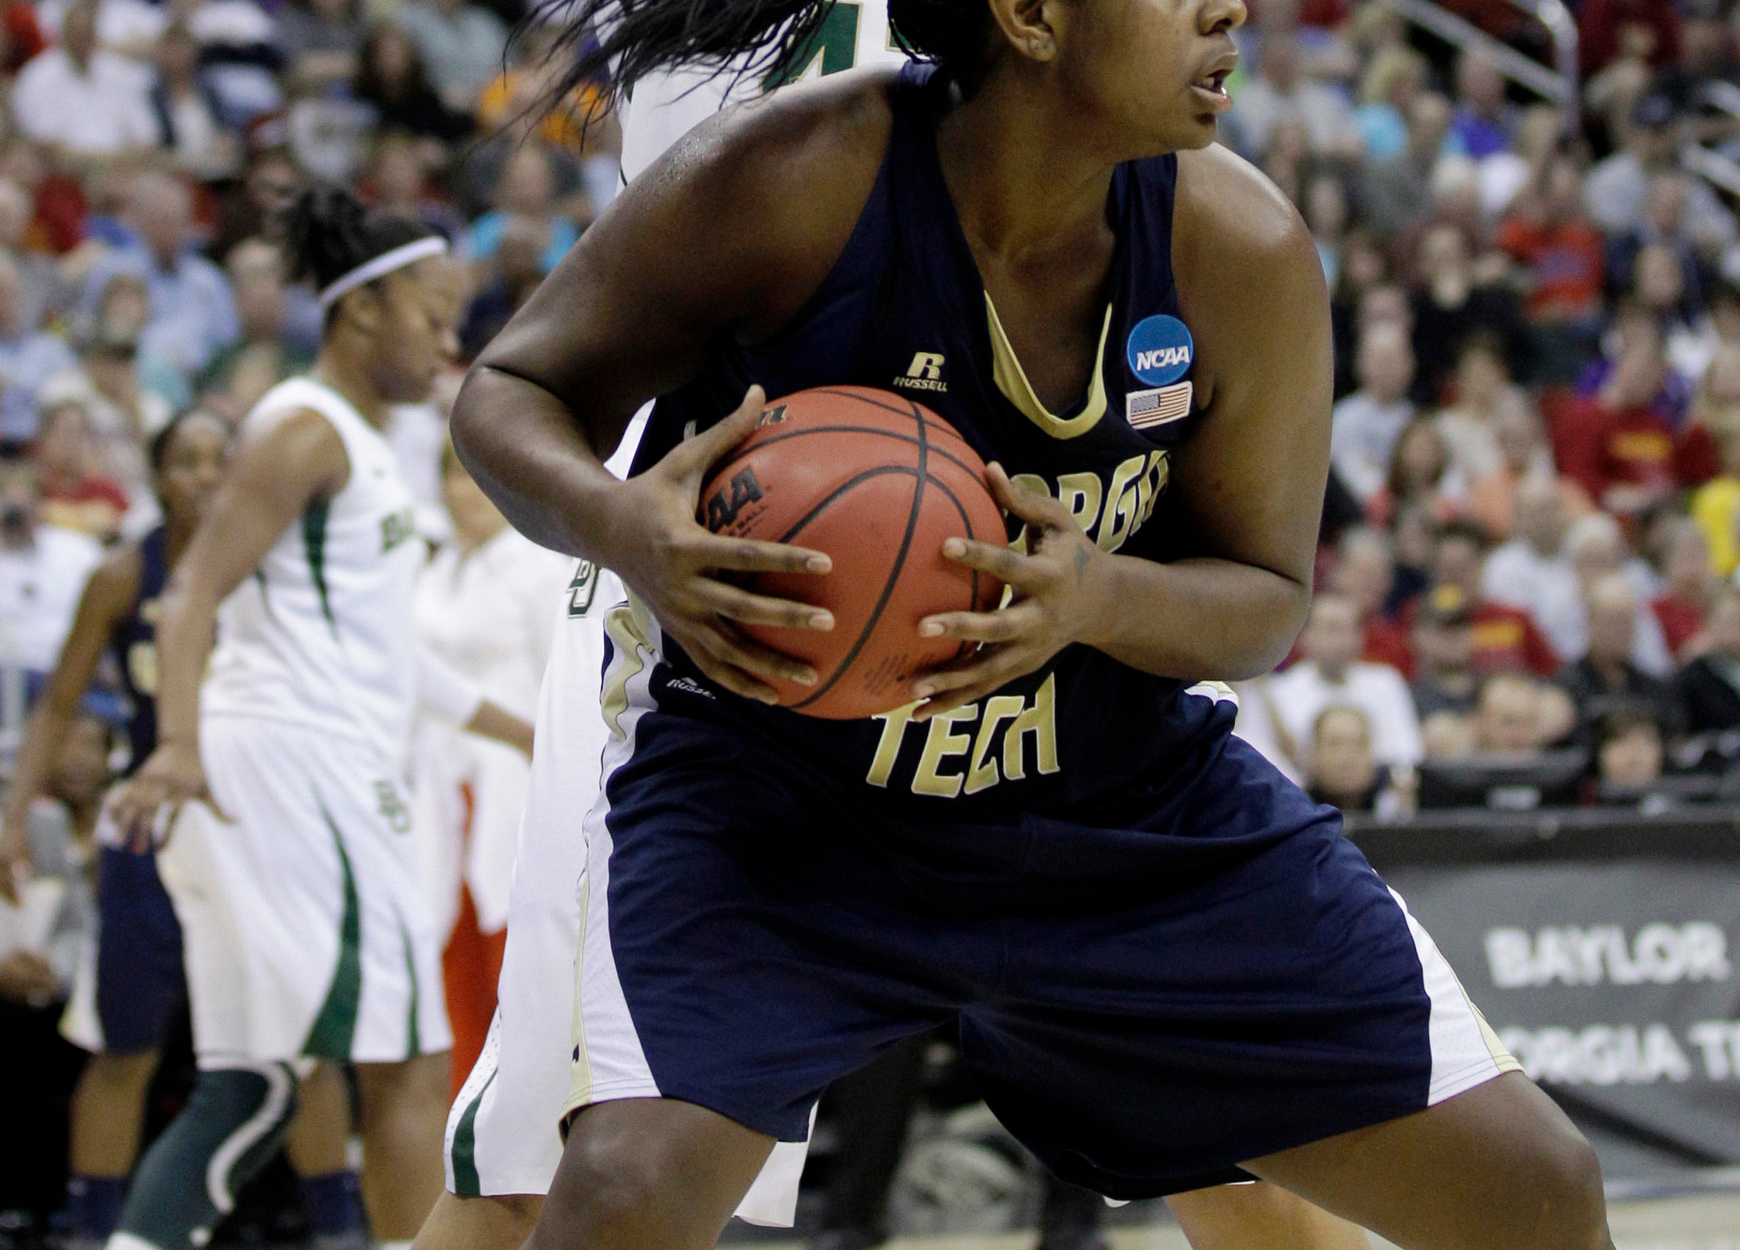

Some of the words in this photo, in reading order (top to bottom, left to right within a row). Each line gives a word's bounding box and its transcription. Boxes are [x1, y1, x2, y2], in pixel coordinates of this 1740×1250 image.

[893, 376, 948, 392] RUSSELL
[1136, 345, 1190, 371] NCAA
[866, 679, 1060, 798] TECH
[1486, 923, 1730, 988] BAYLOR
[1500, 1022, 1692, 1086] ORGIA
